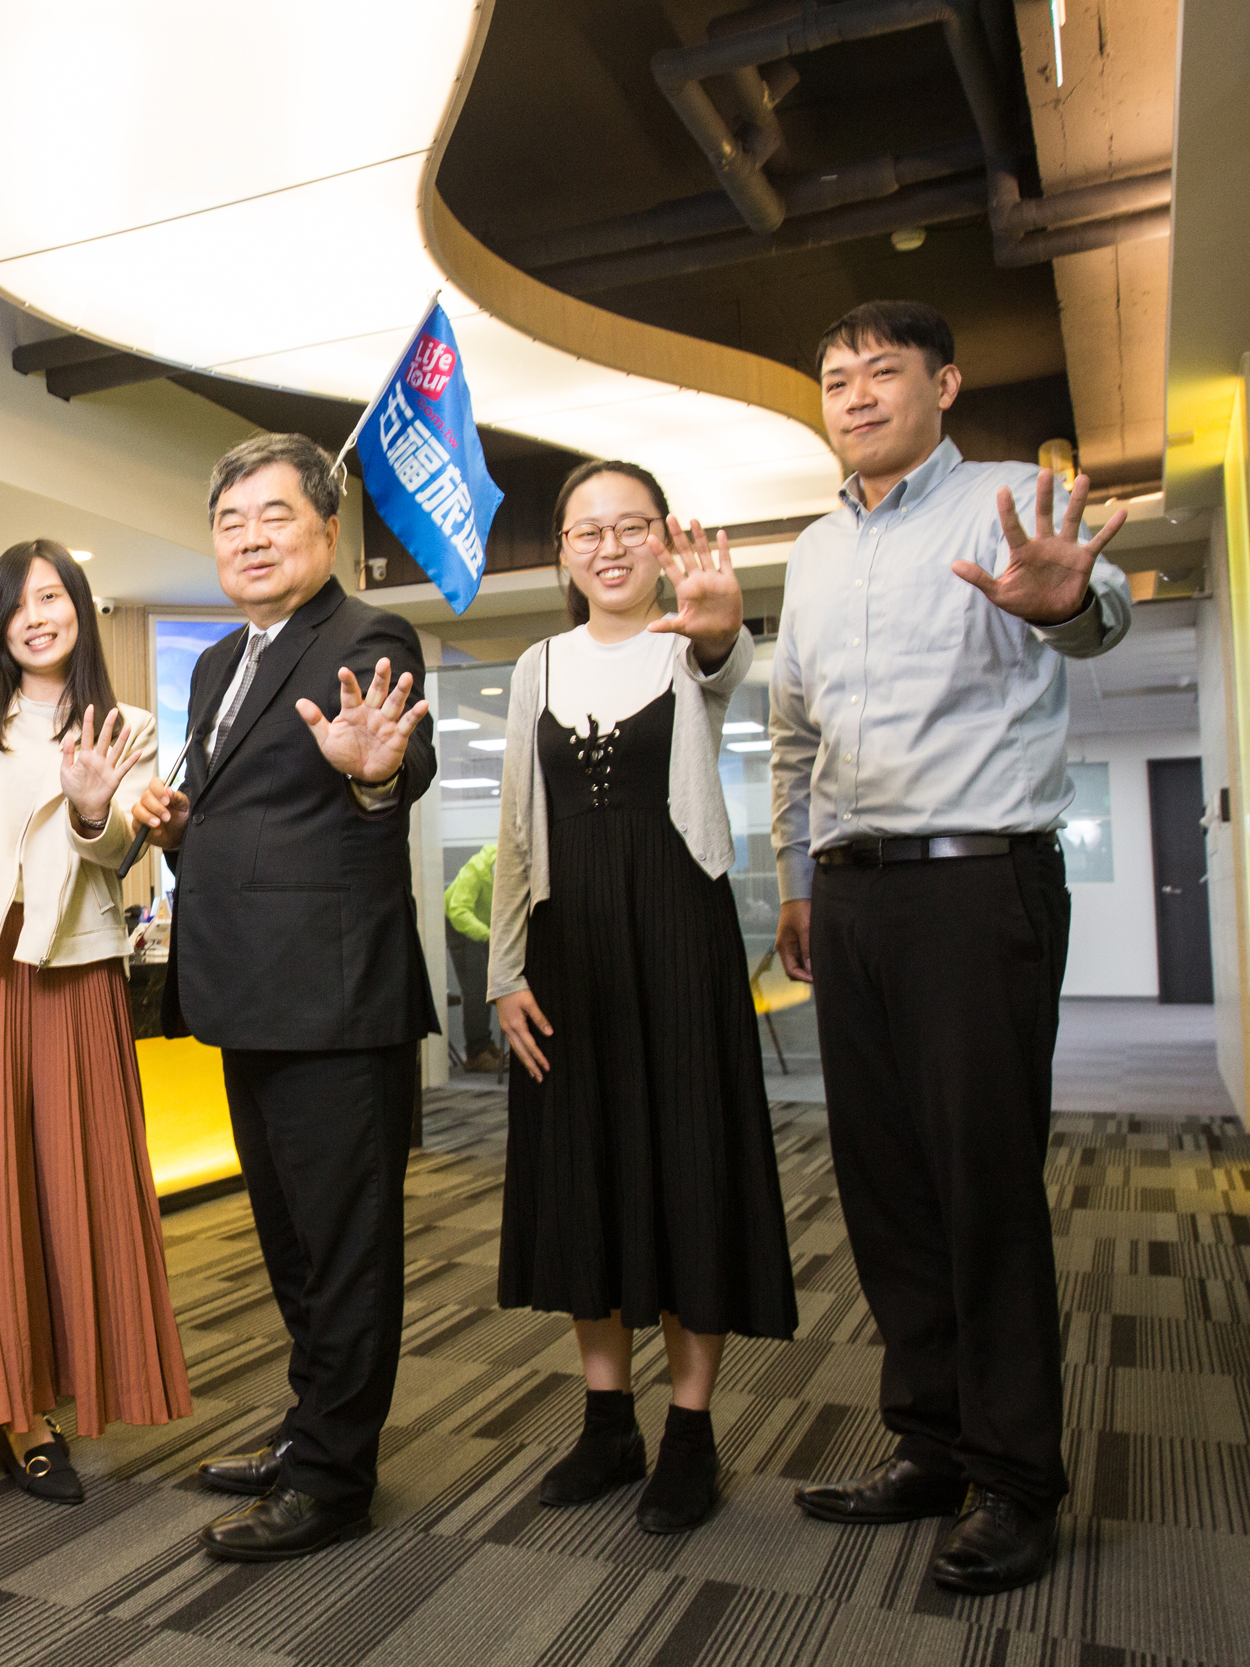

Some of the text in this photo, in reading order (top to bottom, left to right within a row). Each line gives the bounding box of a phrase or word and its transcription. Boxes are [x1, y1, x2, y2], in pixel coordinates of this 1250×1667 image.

[415, 340, 453, 372] Life
[406, 361, 451, 392] Tour
[414, 397, 459, 449] .com.tw
